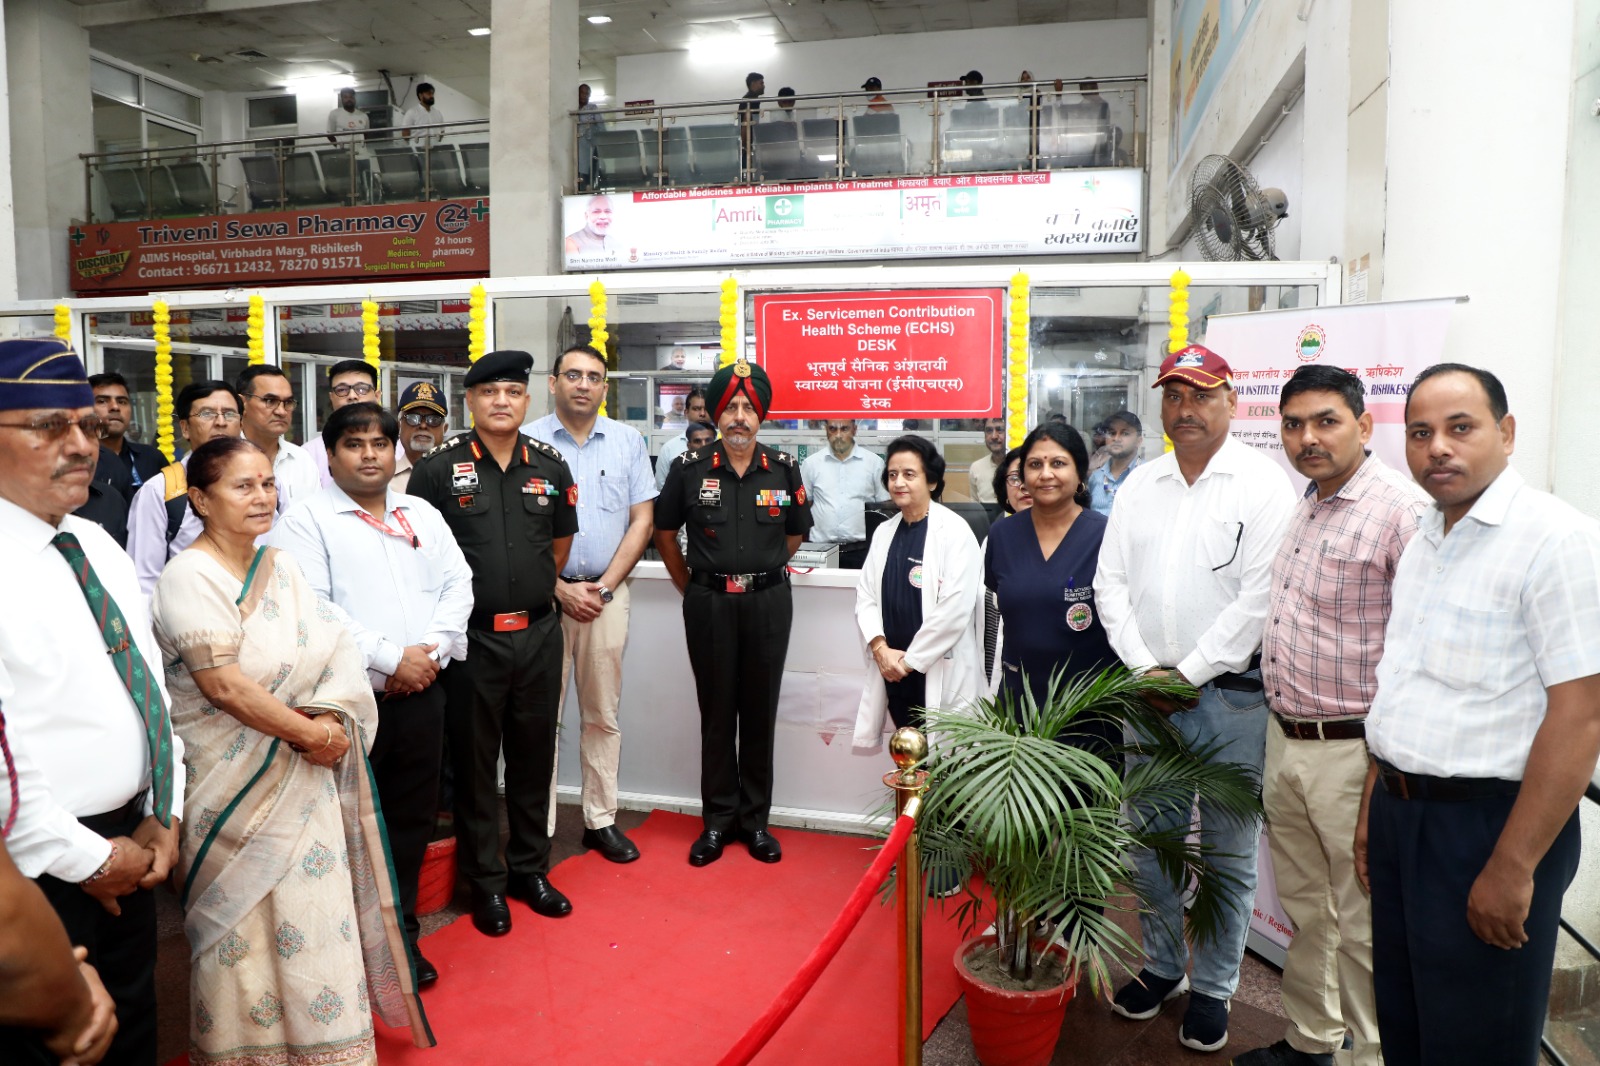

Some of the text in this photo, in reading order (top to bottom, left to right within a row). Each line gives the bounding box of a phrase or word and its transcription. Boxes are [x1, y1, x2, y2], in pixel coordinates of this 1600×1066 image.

[641, 179, 893, 201] Affordable Medicines and Reliable Implants for Treatmet
[906, 195, 941, 217] अमृत
[443, 208, 470, 223] 24
[716, 206, 762, 223] Amrit
[767, 217, 803, 226] PHARMACY
[138, 213, 427, 245] Triveni Sewa Pharmacy
[392, 236, 416, 246] Quality
[435, 236, 473, 245] 24 hours
[139, 242, 362, 263] AIIMS Hospital, Virbhadra Marg, Rishikesh
[387, 249, 422, 258] Medicines,
[432, 247, 475, 258] pharmacy
[78, 253, 125, 269] DISCOUNT
[138, 265, 184, 278] Contact
[193, 262, 231, 276] 96671
[234, 261, 276, 274] 12432,
[279, 258, 319, 271] 78270
[322, 256, 362, 269] 91571
[364, 260, 446, 273] Surgical Items & Implants
[782, 304, 975, 321] Ex. Servicemen Contribution
[801, 321, 955, 337] Health Scheme (ECHS)
[857, 338, 897, 351] DESK
[806, 356, 947, 377] भूतपूर्व सैनिक अंशदायी
[1232, 368, 1249, 380] खिल
[1252, 367, 1280, 380] भारतीय
[1366, 363, 1404, 378] ऋषिकेश
[794, 375, 964, 393] स्वास्थ्य योजना (ईसीएचएस)
[1246, 384, 1280, 396] INSTITUTE
[860, 394, 892, 408] डेस्क
[1248, 405, 1276, 417] ECHS
